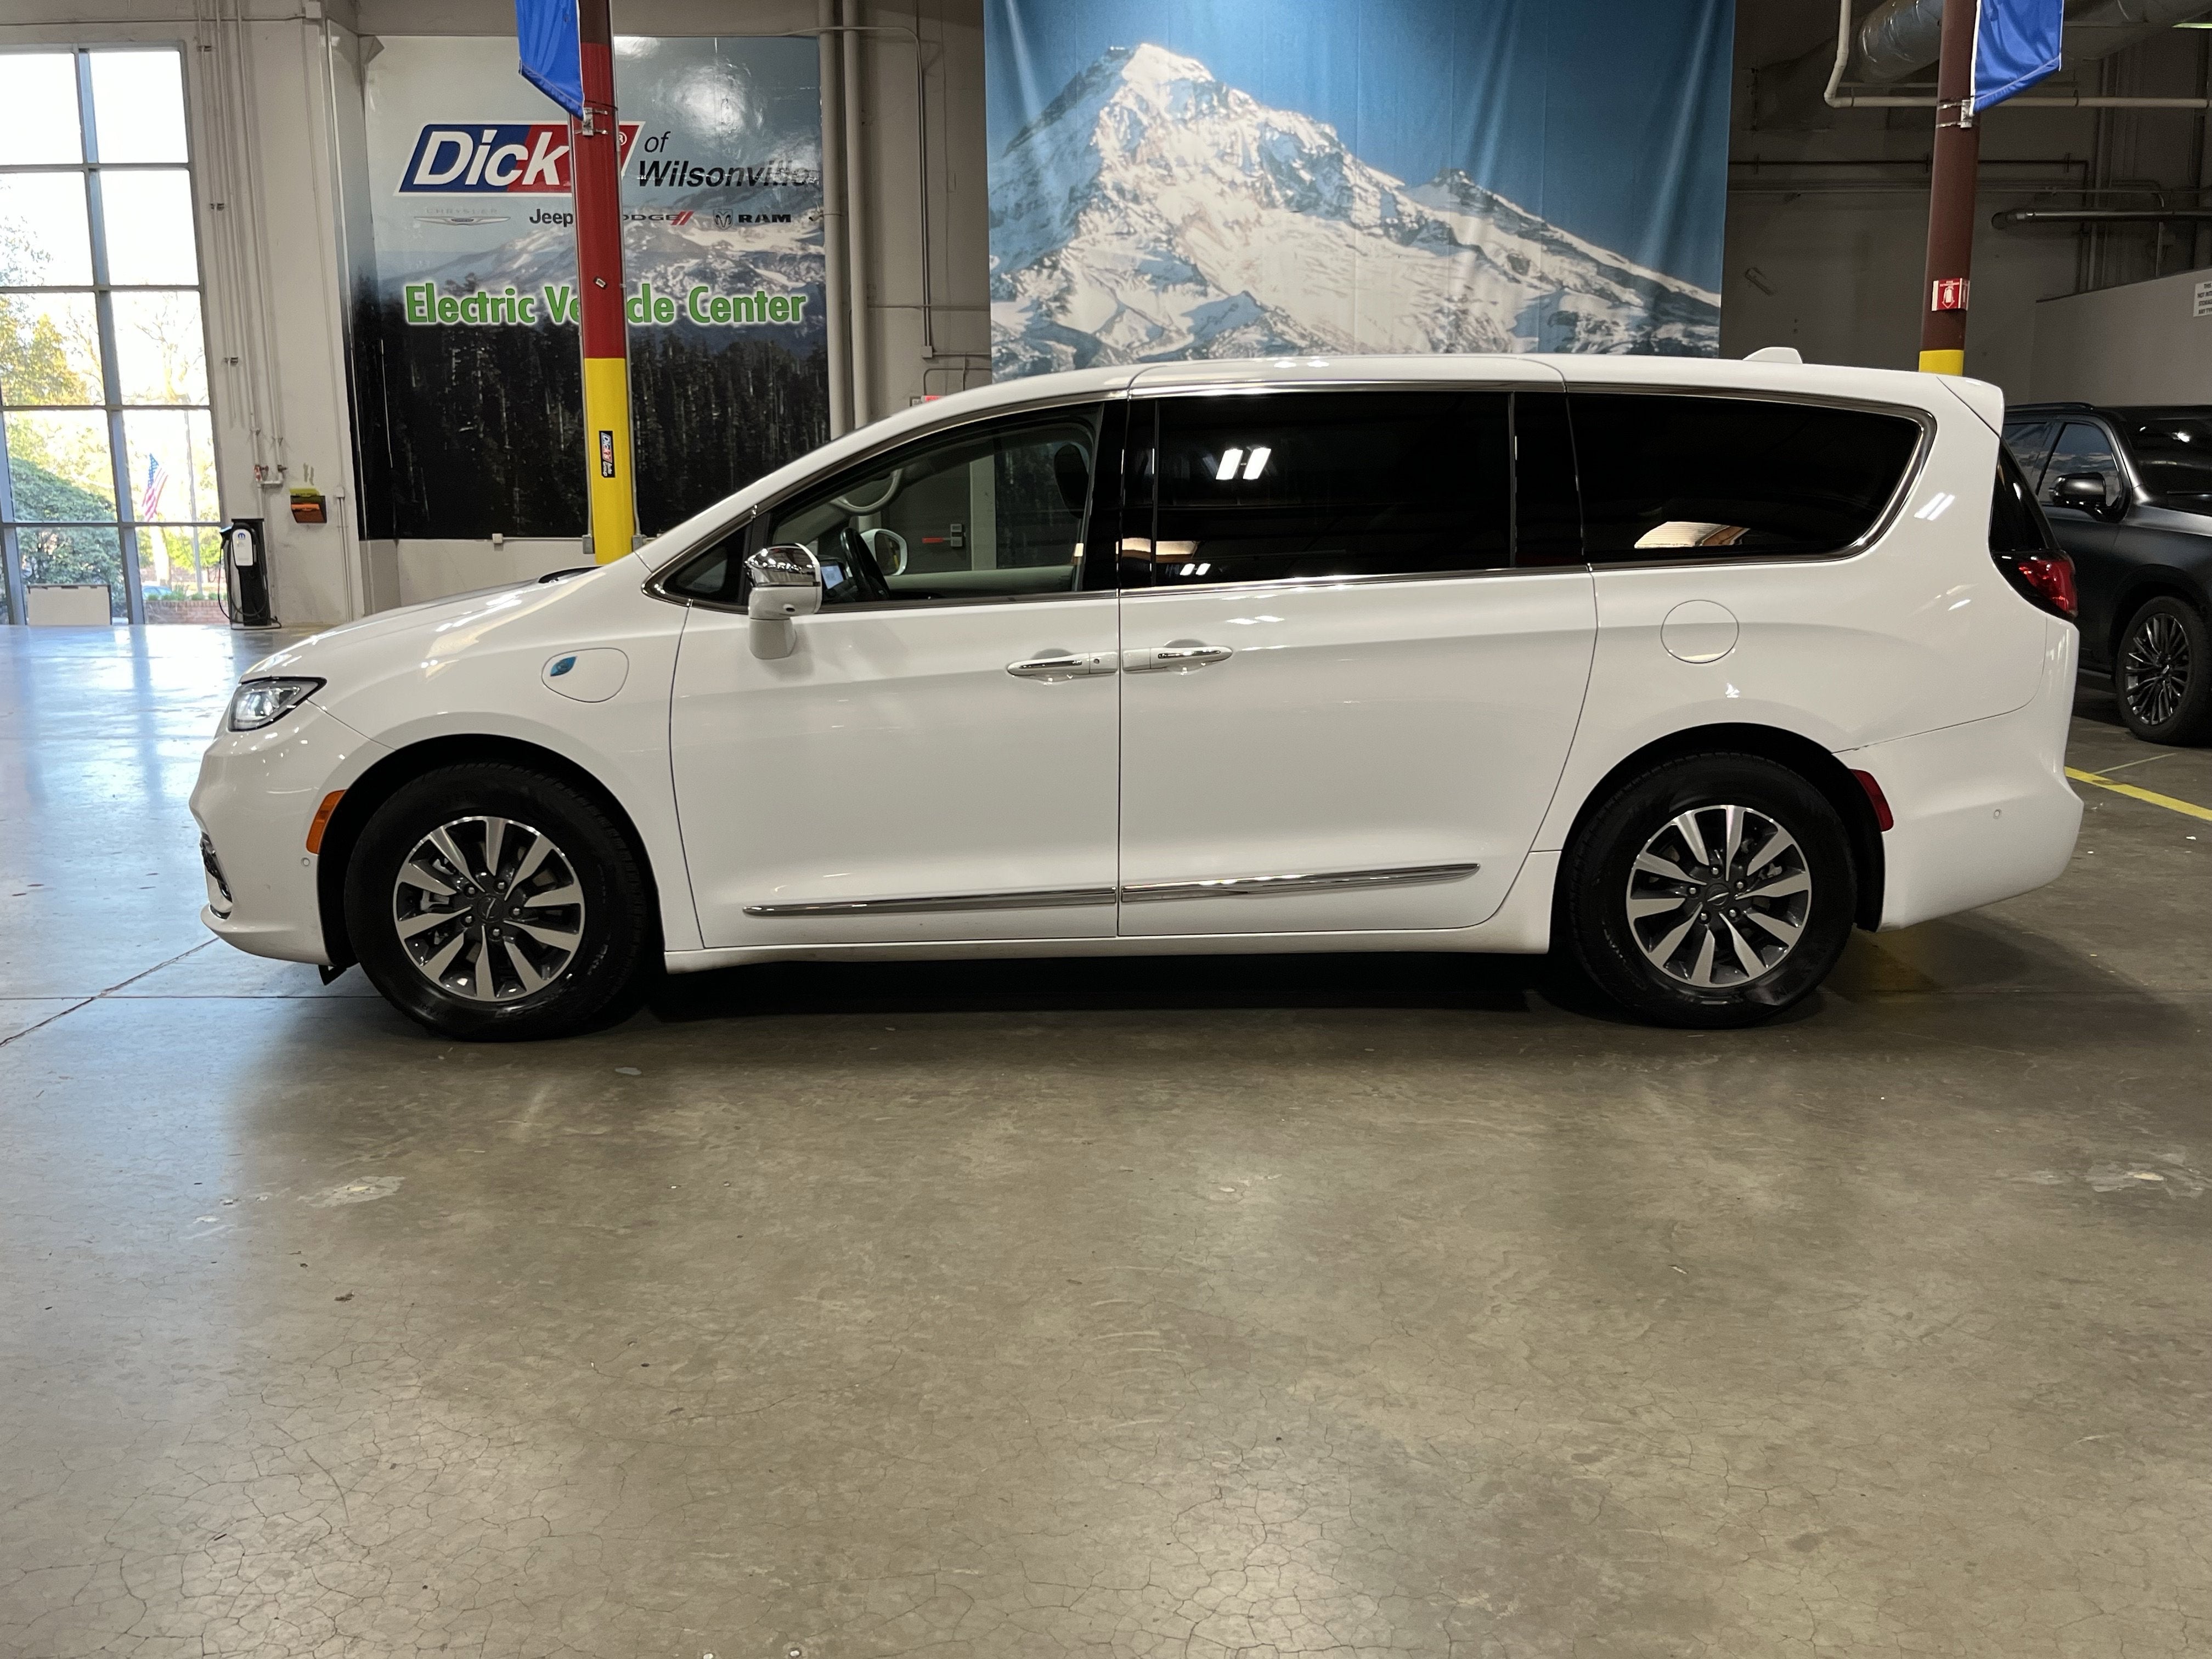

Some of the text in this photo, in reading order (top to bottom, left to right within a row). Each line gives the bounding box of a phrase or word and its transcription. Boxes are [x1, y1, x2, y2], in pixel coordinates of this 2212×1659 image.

[644, 131, 671, 153] of
[413, 129, 569, 186] Dick
[529, 208, 573, 228] Jeep
[738, 214, 791, 223] RAM
[405, 283, 806, 323] Electric Vcle Center
